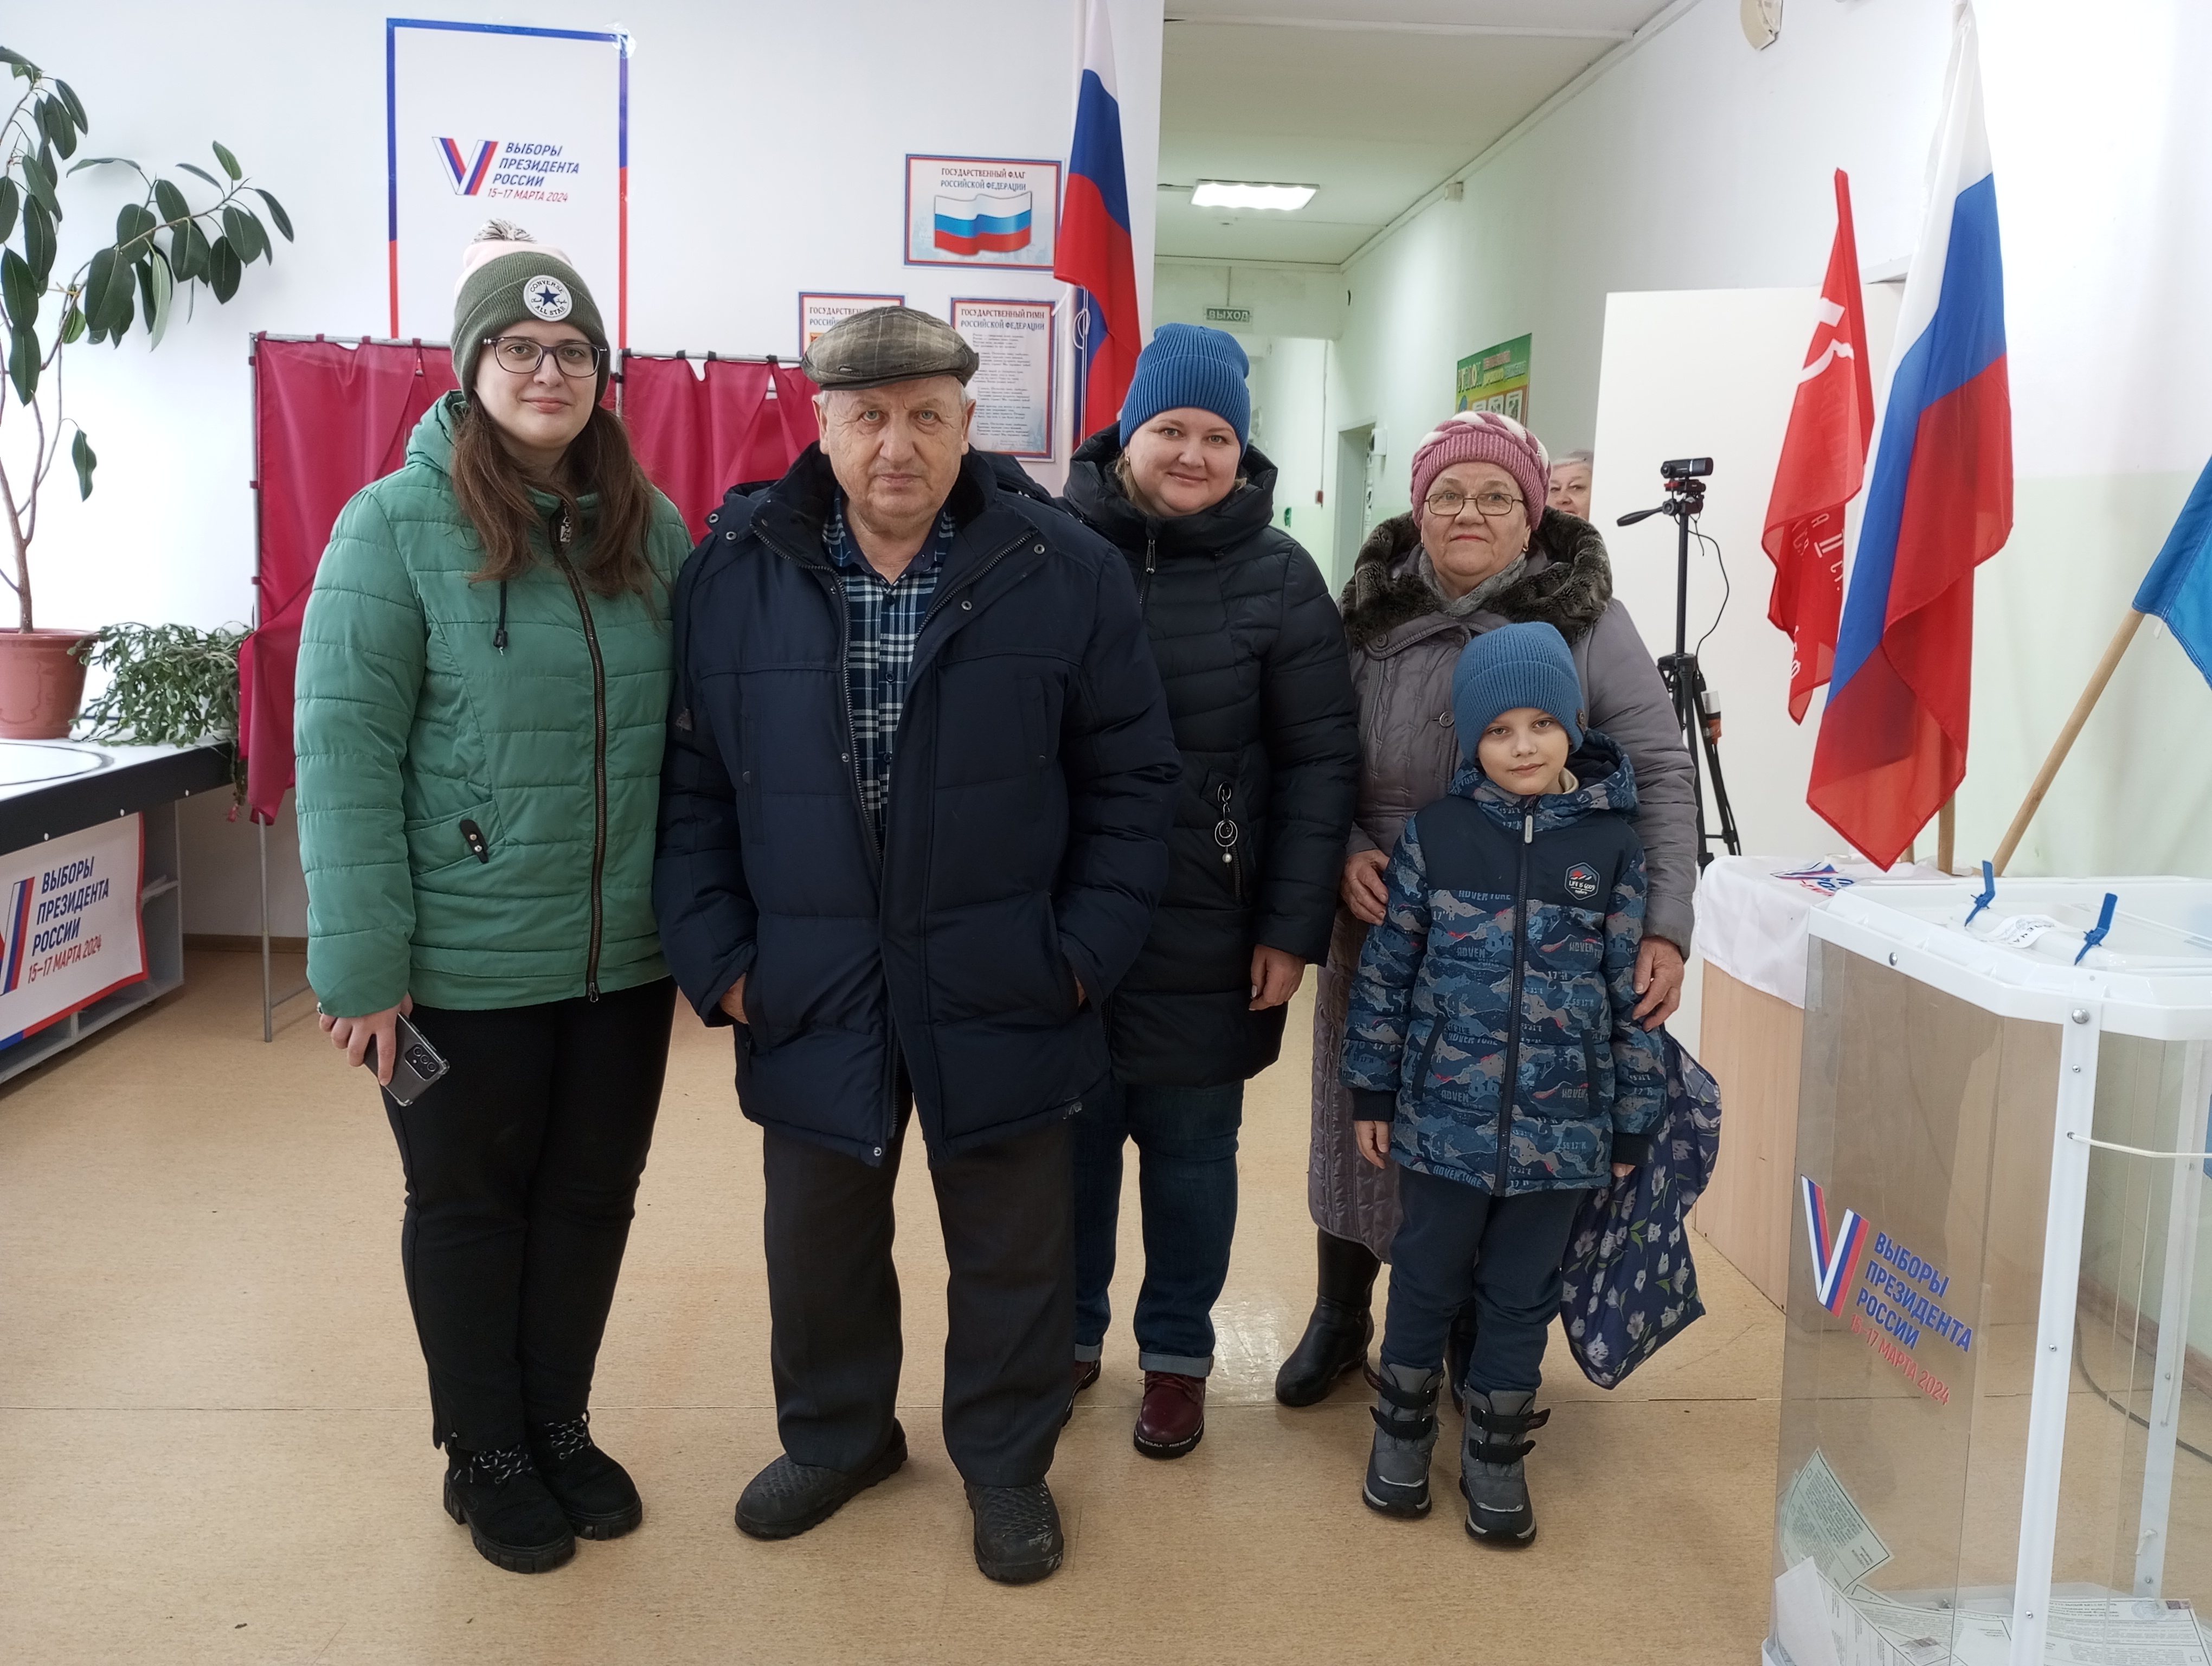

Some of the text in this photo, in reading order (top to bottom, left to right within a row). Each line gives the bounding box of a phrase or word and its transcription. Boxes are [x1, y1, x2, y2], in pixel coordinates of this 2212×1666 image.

[505, 142, 563, 157] ВЫБОРЫ
[499, 158, 579, 174] ПРЕЗИДЕНТА
[941, 168, 1007, 178] ГОСУДАРСТВЕННЫЙ
[492, 173, 545, 187] РОССИИ
[941, 178, 1026, 191] РОССИЙСКОЙ ФЕДЕРАЦИИ
[513, 189, 544, 201] МАРТА
[546, 191, 569, 202] 2024
[530, 280, 564, 293] CONVERSE
[535, 305, 566, 315] ALL STAR
[961, 309, 1045, 319] ГОСУДАРСТВЕННЫЙ ГИМН
[1209, 310, 1249, 322] ВЫХОД
[961, 318, 1045, 331] РОССИЙСКОЙ ФЕДЕРАЦИИ
[42, 856, 95, 894] ВЫБОРЫ
[37, 878, 110, 925] ПРЕЗИДЕНТА
[31, 917, 81, 957] РОССИИ
[53, 945, 81, 972] МАРТА
[82, 934, 102, 959] 2024
[1874, 1231, 1950, 1298] ВЫБОРЫ
[1865, 1259, 1972, 1353] ПРЕЗИДЕНТА
[1856, 1286, 1920, 1350] РОССИИ
[1877, 1338, 1918, 1381] МАРТА
[1917, 1369, 1950, 1406] 2024
